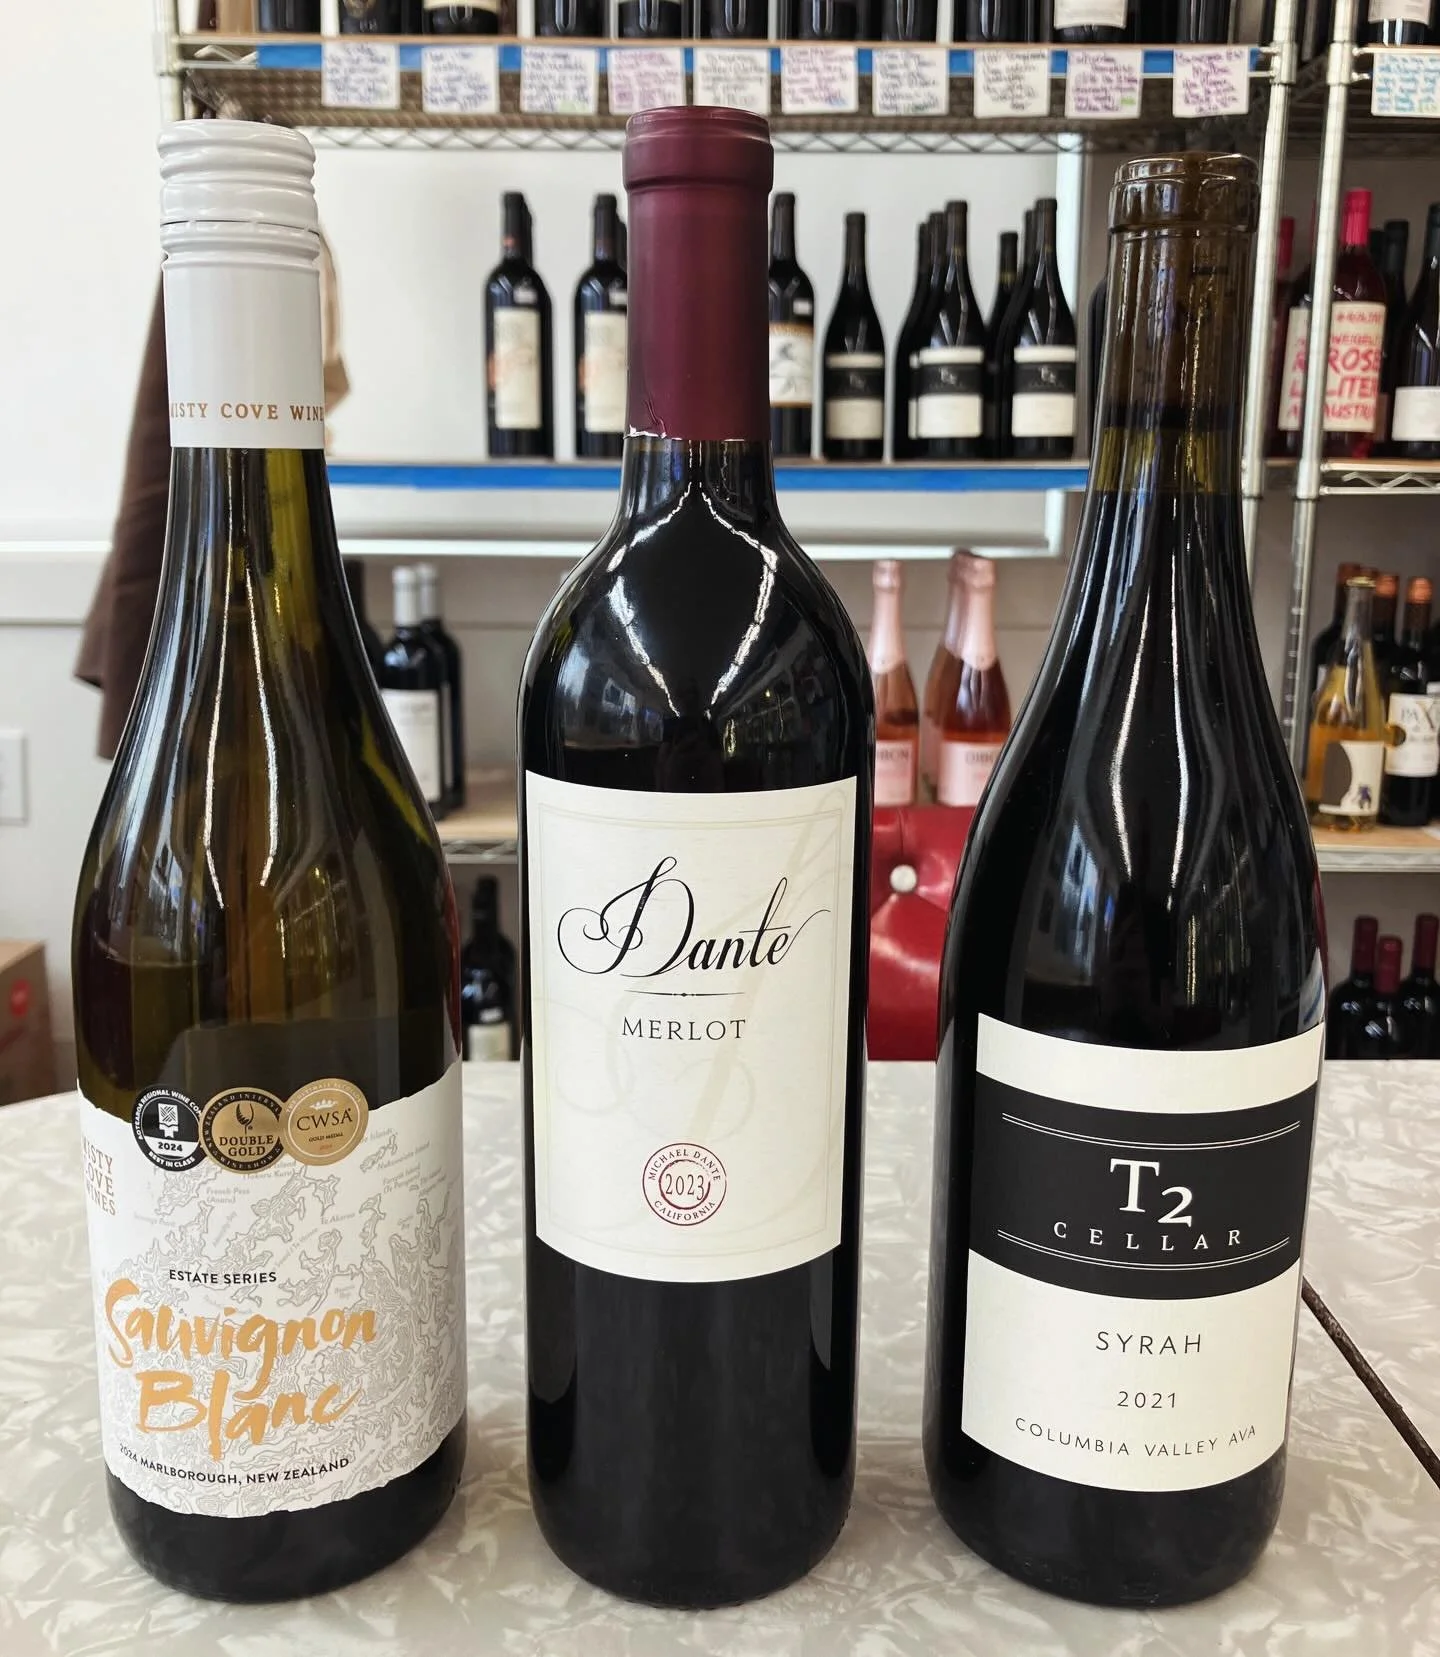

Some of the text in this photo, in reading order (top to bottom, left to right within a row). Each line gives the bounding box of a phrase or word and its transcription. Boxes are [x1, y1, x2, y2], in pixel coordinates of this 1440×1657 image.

[221, 403, 278, 419] COVE
[557, 856, 831, 978] Dante
[621, 1016, 746, 1041] MERLOT
[141, 1090, 170, 1103] REGIONAL
[171, 1091, 190, 1103] WINE
[296, 1109, 352, 1131] CWSA
[158, 1142, 183, 1152] 2024
[219, 1135, 274, 1146] DOUBLE
[326, 1132, 343, 1140] MEDAL
[148, 1151, 164, 1165] BEST
[174, 1156, 195, 1167] CLASS
[228, 1146, 266, 1156] GOLD
[648, 1149, 720, 1181] MICHAEL DANTE
[86, 1162, 114, 1197] OVE
[665, 1173, 704, 1201] 2023
[1109, 1158, 1193, 1228] T2
[654, 1200, 715, 1221] CALIFORNIA
[1053, 1221, 1241, 1251] CELLAR
[169, 1269, 277, 1284] ESTATE SERIES
[105, 1278, 377, 1400] Sauvignon
[1096, 1331, 1201, 1354] SYRAH
[1117, 1390, 1176, 1408] 2021
[135, 1369, 363, 1462] Blanc
[1015, 1417, 1256, 1456] COLUMBIA VALLEY AVA
[120, 1443, 349, 1485] 2024 MARLBOROUGH, NEW ZEALAND
